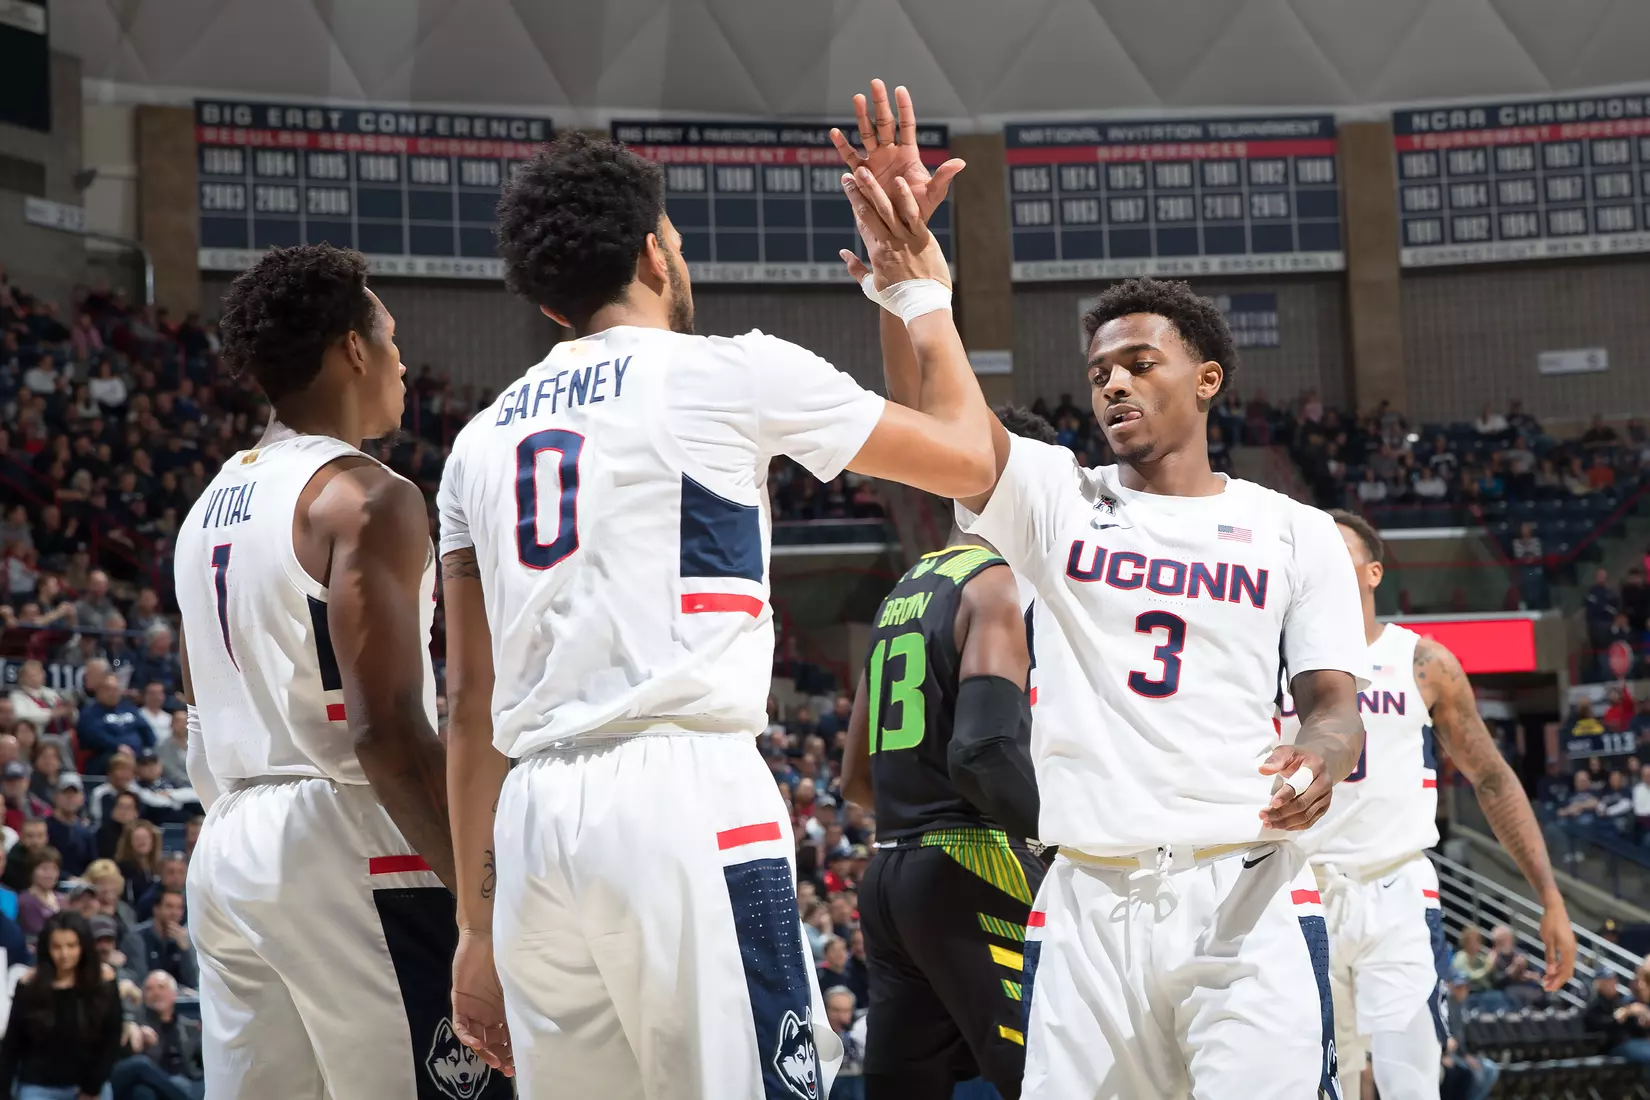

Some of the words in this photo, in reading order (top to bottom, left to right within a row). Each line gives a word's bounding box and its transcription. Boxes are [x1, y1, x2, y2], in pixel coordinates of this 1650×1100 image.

[202, 103, 252, 125] BIG
[267, 107, 344, 131] EAST
[357, 112, 545, 140] CONFERENCE
[780, 128, 828, 144] ATHLE
[1018, 127, 1104, 144] NATIONAL
[1107, 123, 1203, 142] INVITATION
[1207, 119, 1320, 138] TOURNAMENT
[1411, 108, 1487, 132] NCAA
[1411, 124, 1549, 150] TOURNAMENT
[203, 127, 308, 148] REGULAR
[319, 133, 408, 153] SEASON
[644, 147, 786, 164] TOURNAMENT
[1096, 141, 1249, 160] APPEARANCES
[495, 355, 634, 427] GAFFNEY
[202, 480, 257, 529] VITAL
[515, 428, 585, 571] 0
[1065, 539, 1270, 610] UCONN
[210, 542, 241, 674] 1
[1127, 610, 1188, 700] 3
[869, 631, 927, 756] 13
